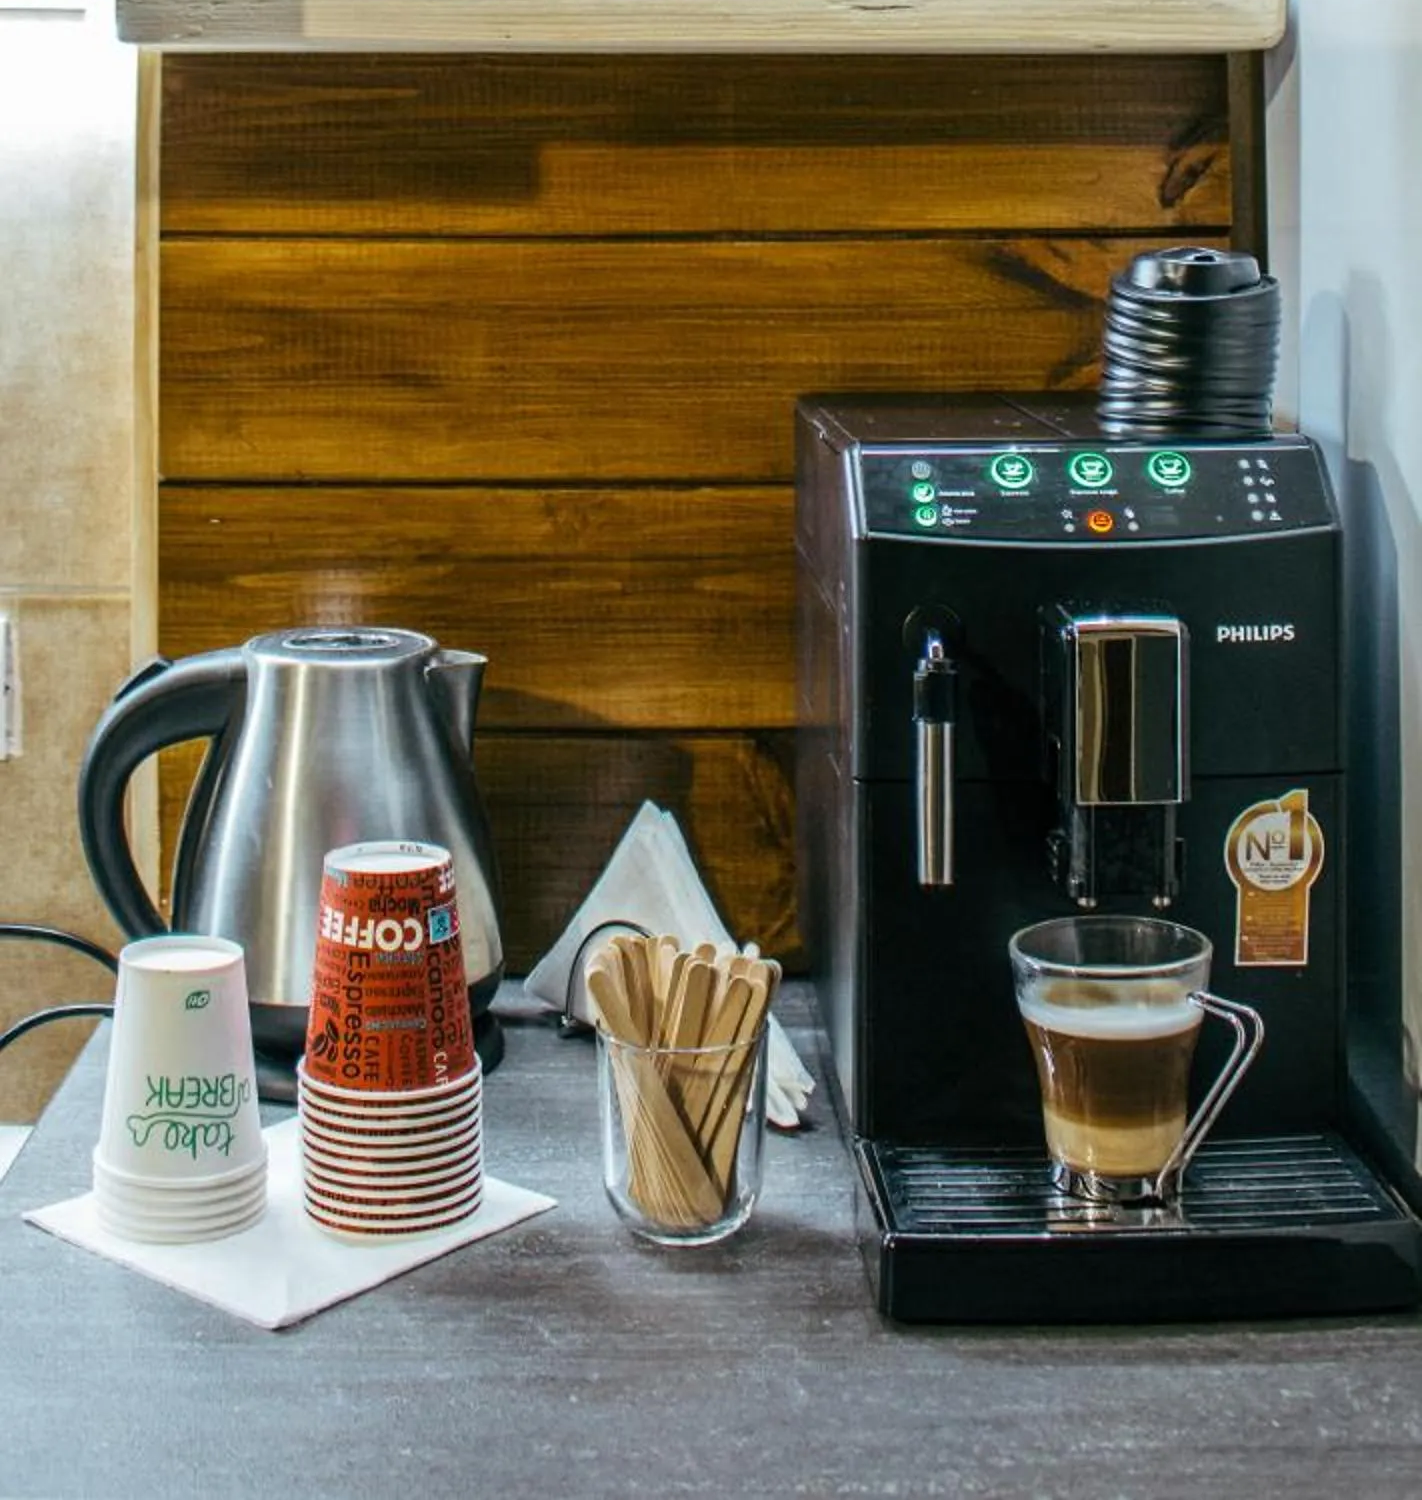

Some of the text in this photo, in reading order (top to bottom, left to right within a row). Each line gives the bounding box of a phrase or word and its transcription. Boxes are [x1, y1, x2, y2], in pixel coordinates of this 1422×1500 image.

[1216, 623, 1296, 643] PHILIPS
[319, 904, 424, 952] COFFEE
[341, 951, 371, 1079] Espresso
[363, 1035, 381, 1083] CAFE
[145, 1073, 236, 1109] BREAK
